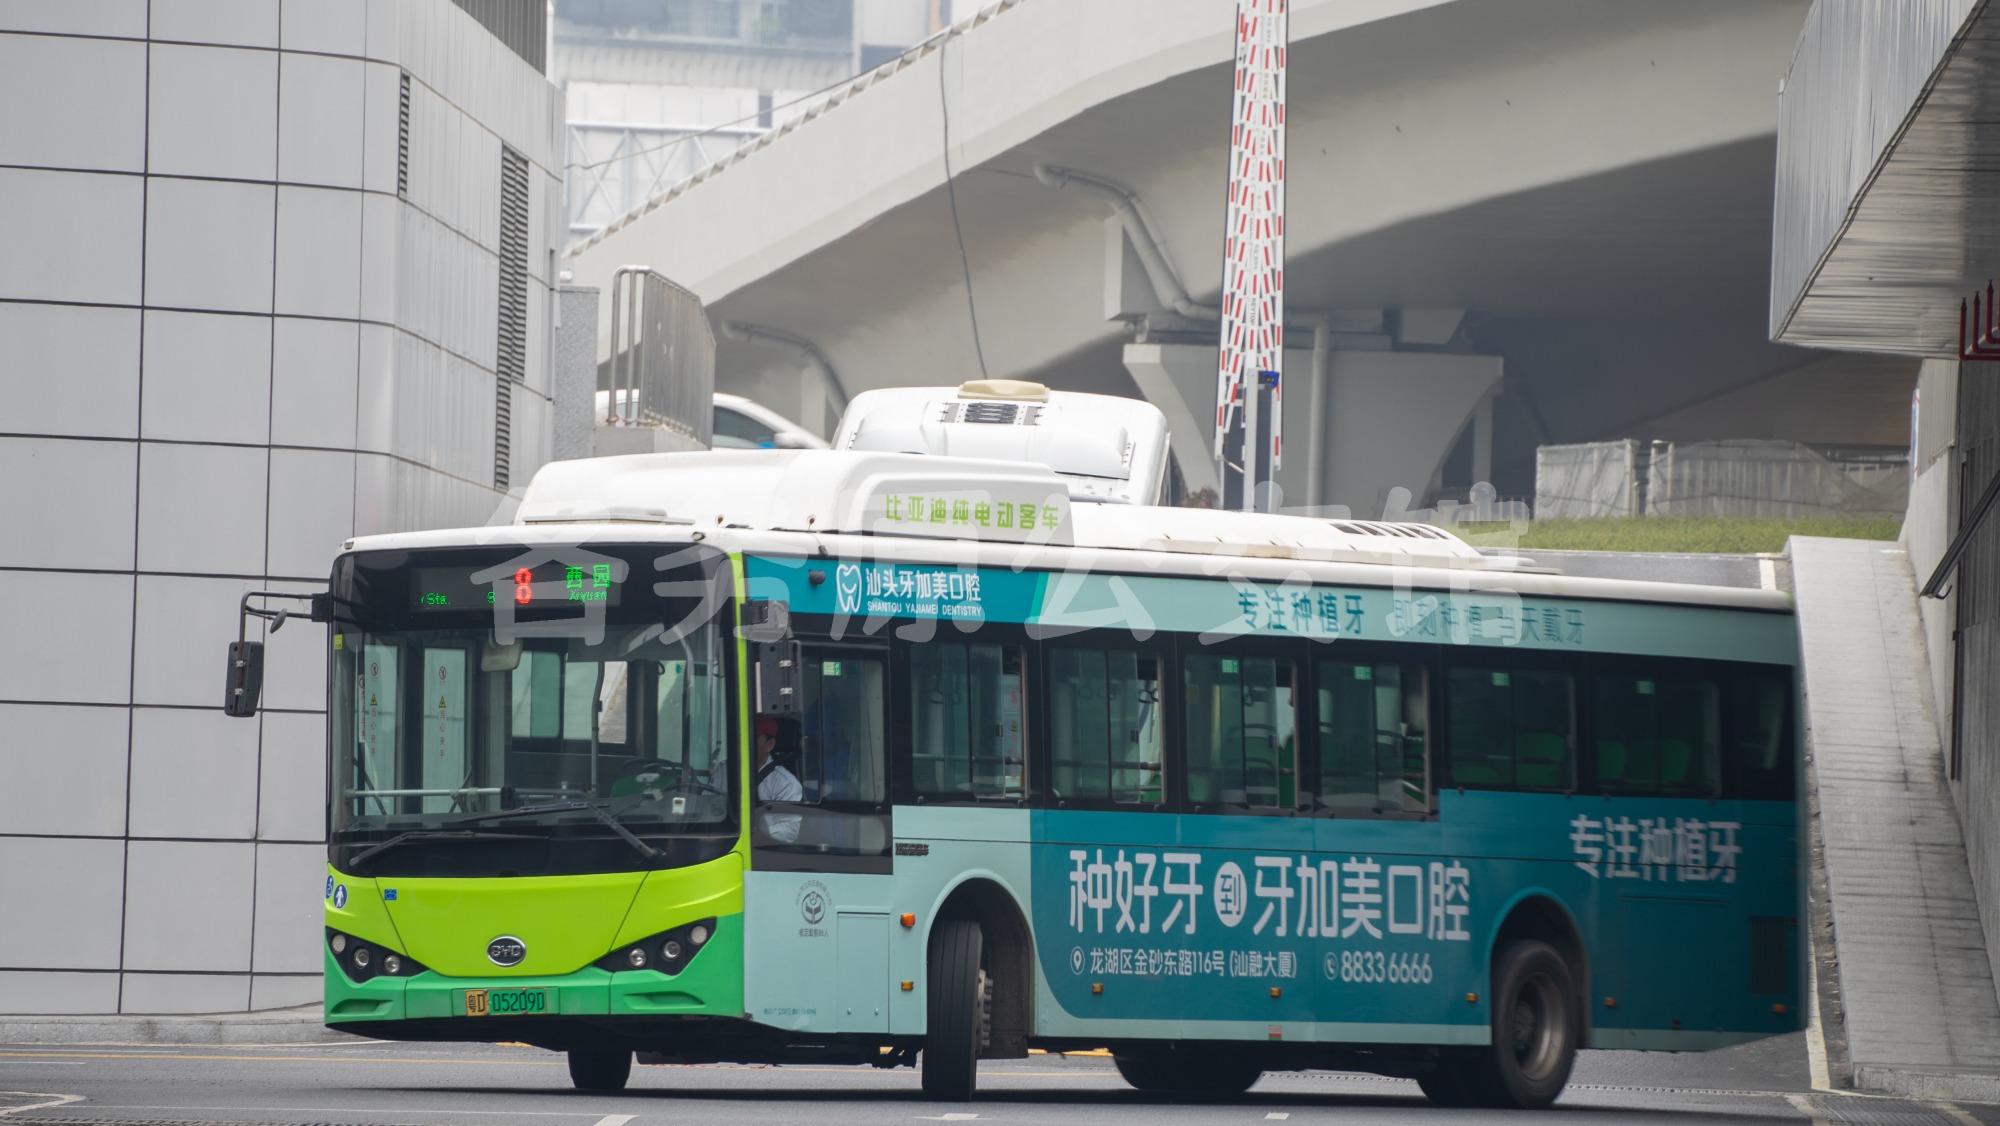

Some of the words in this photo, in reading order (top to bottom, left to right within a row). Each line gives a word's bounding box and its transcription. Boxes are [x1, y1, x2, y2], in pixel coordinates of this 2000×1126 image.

[886, 494, 1059, 530] 比亚迪纯电动客车
[515, 567, 532, 604] 8
[565, 563, 610, 588] 西园
[866, 566, 981, 602] 汕头牙加美口腔
[568, 589, 607, 604] Xiyuan
[867, 600, 902, 613] SHANTOU
[905, 602, 938, 615] YAJIAMEI
[942, 605, 981, 617] DENTISTRY
[1238, 588, 1364, 635] 专注种植牙
[1569, 814, 1743, 884] 专注种植牙
[490, 945, 522, 957] BYD
[1090, 947, 1225, 977] 龙湖区金砂东路116号
[1341, 950, 1433, 984] 88336666
